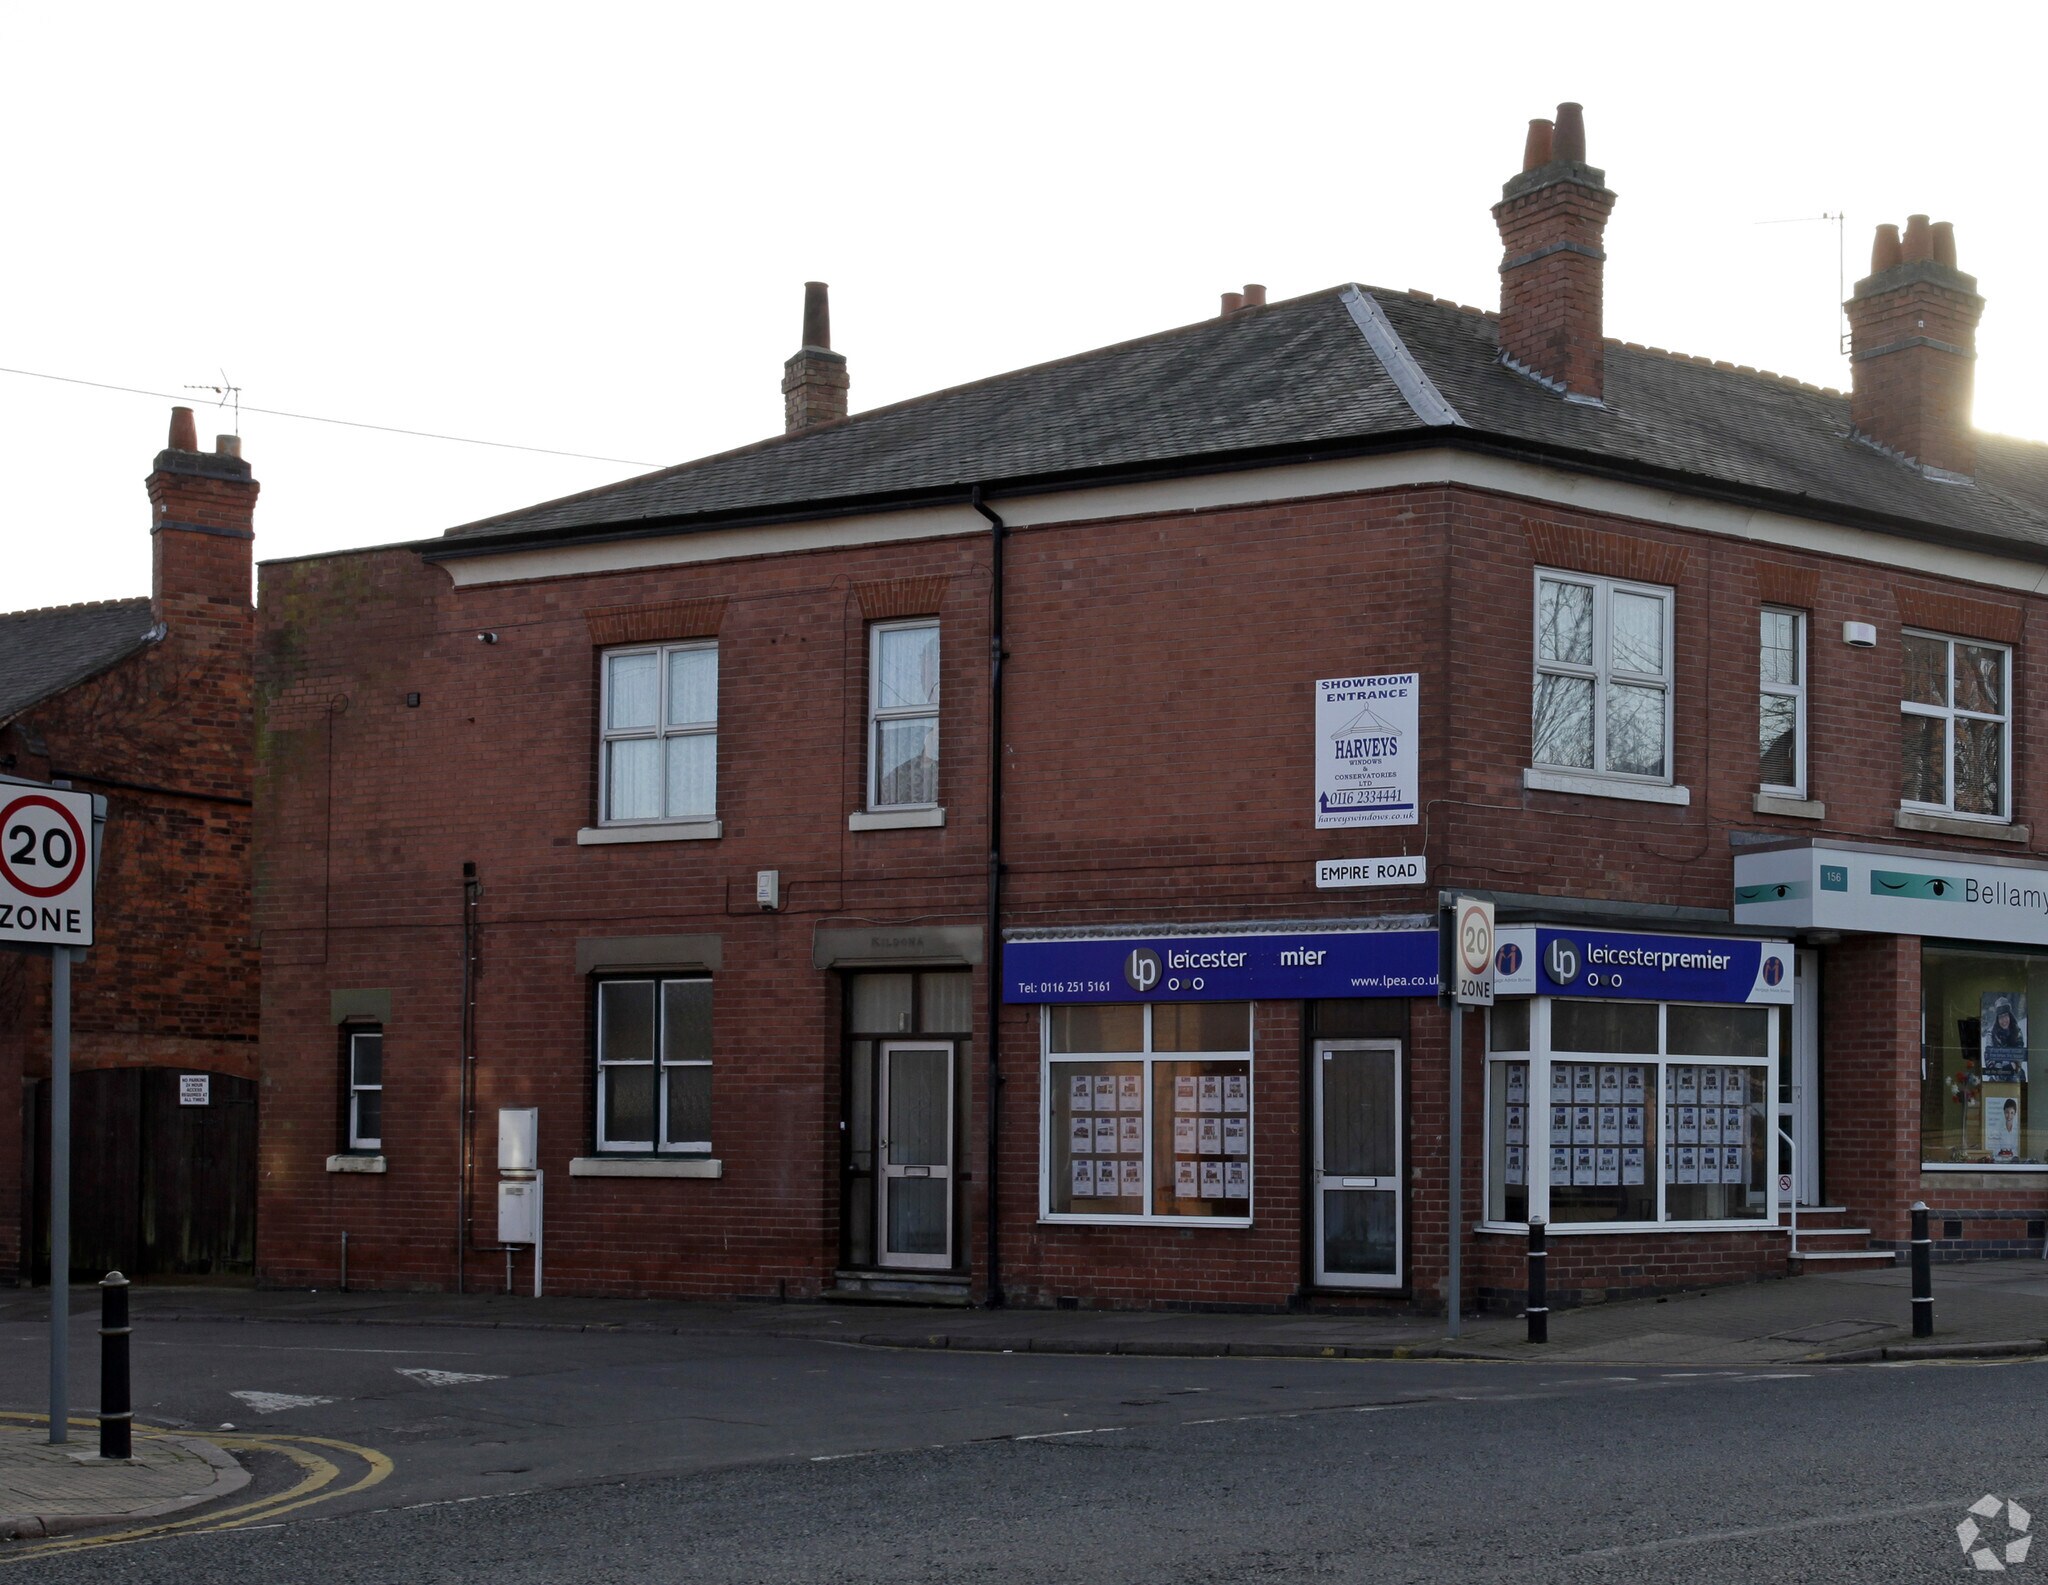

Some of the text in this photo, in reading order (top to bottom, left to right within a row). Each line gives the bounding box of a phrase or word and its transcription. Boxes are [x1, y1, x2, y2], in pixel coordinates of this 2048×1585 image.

[1321, 676, 1412, 690] SHOWROOM
[1326, 689, 1408, 702] ENTRANCE
[1335, 736, 1398, 759] HARVEYS
[1334, 772, 1398, 780] CONSERVATORIES
[1330, 789, 1402, 805] 0116 2334441
[1318, 811, 1415, 825] harveyswindows.co.uk
[9, 824, 72, 868] 20
[1321, 863, 1417, 881] EMPIRE ROAD
[1826, 871, 1842, 882] 156
[0, 904, 81, 933] ZONE
[1465, 926, 1488, 955] 20
[1168, 946, 1327, 969] leicester mier
[1587, 943, 1731, 972] leicesterpremier
[1018, 981, 1110, 994] Tel: 0116 251 5161
[1461, 980, 1490, 998] ZONE
